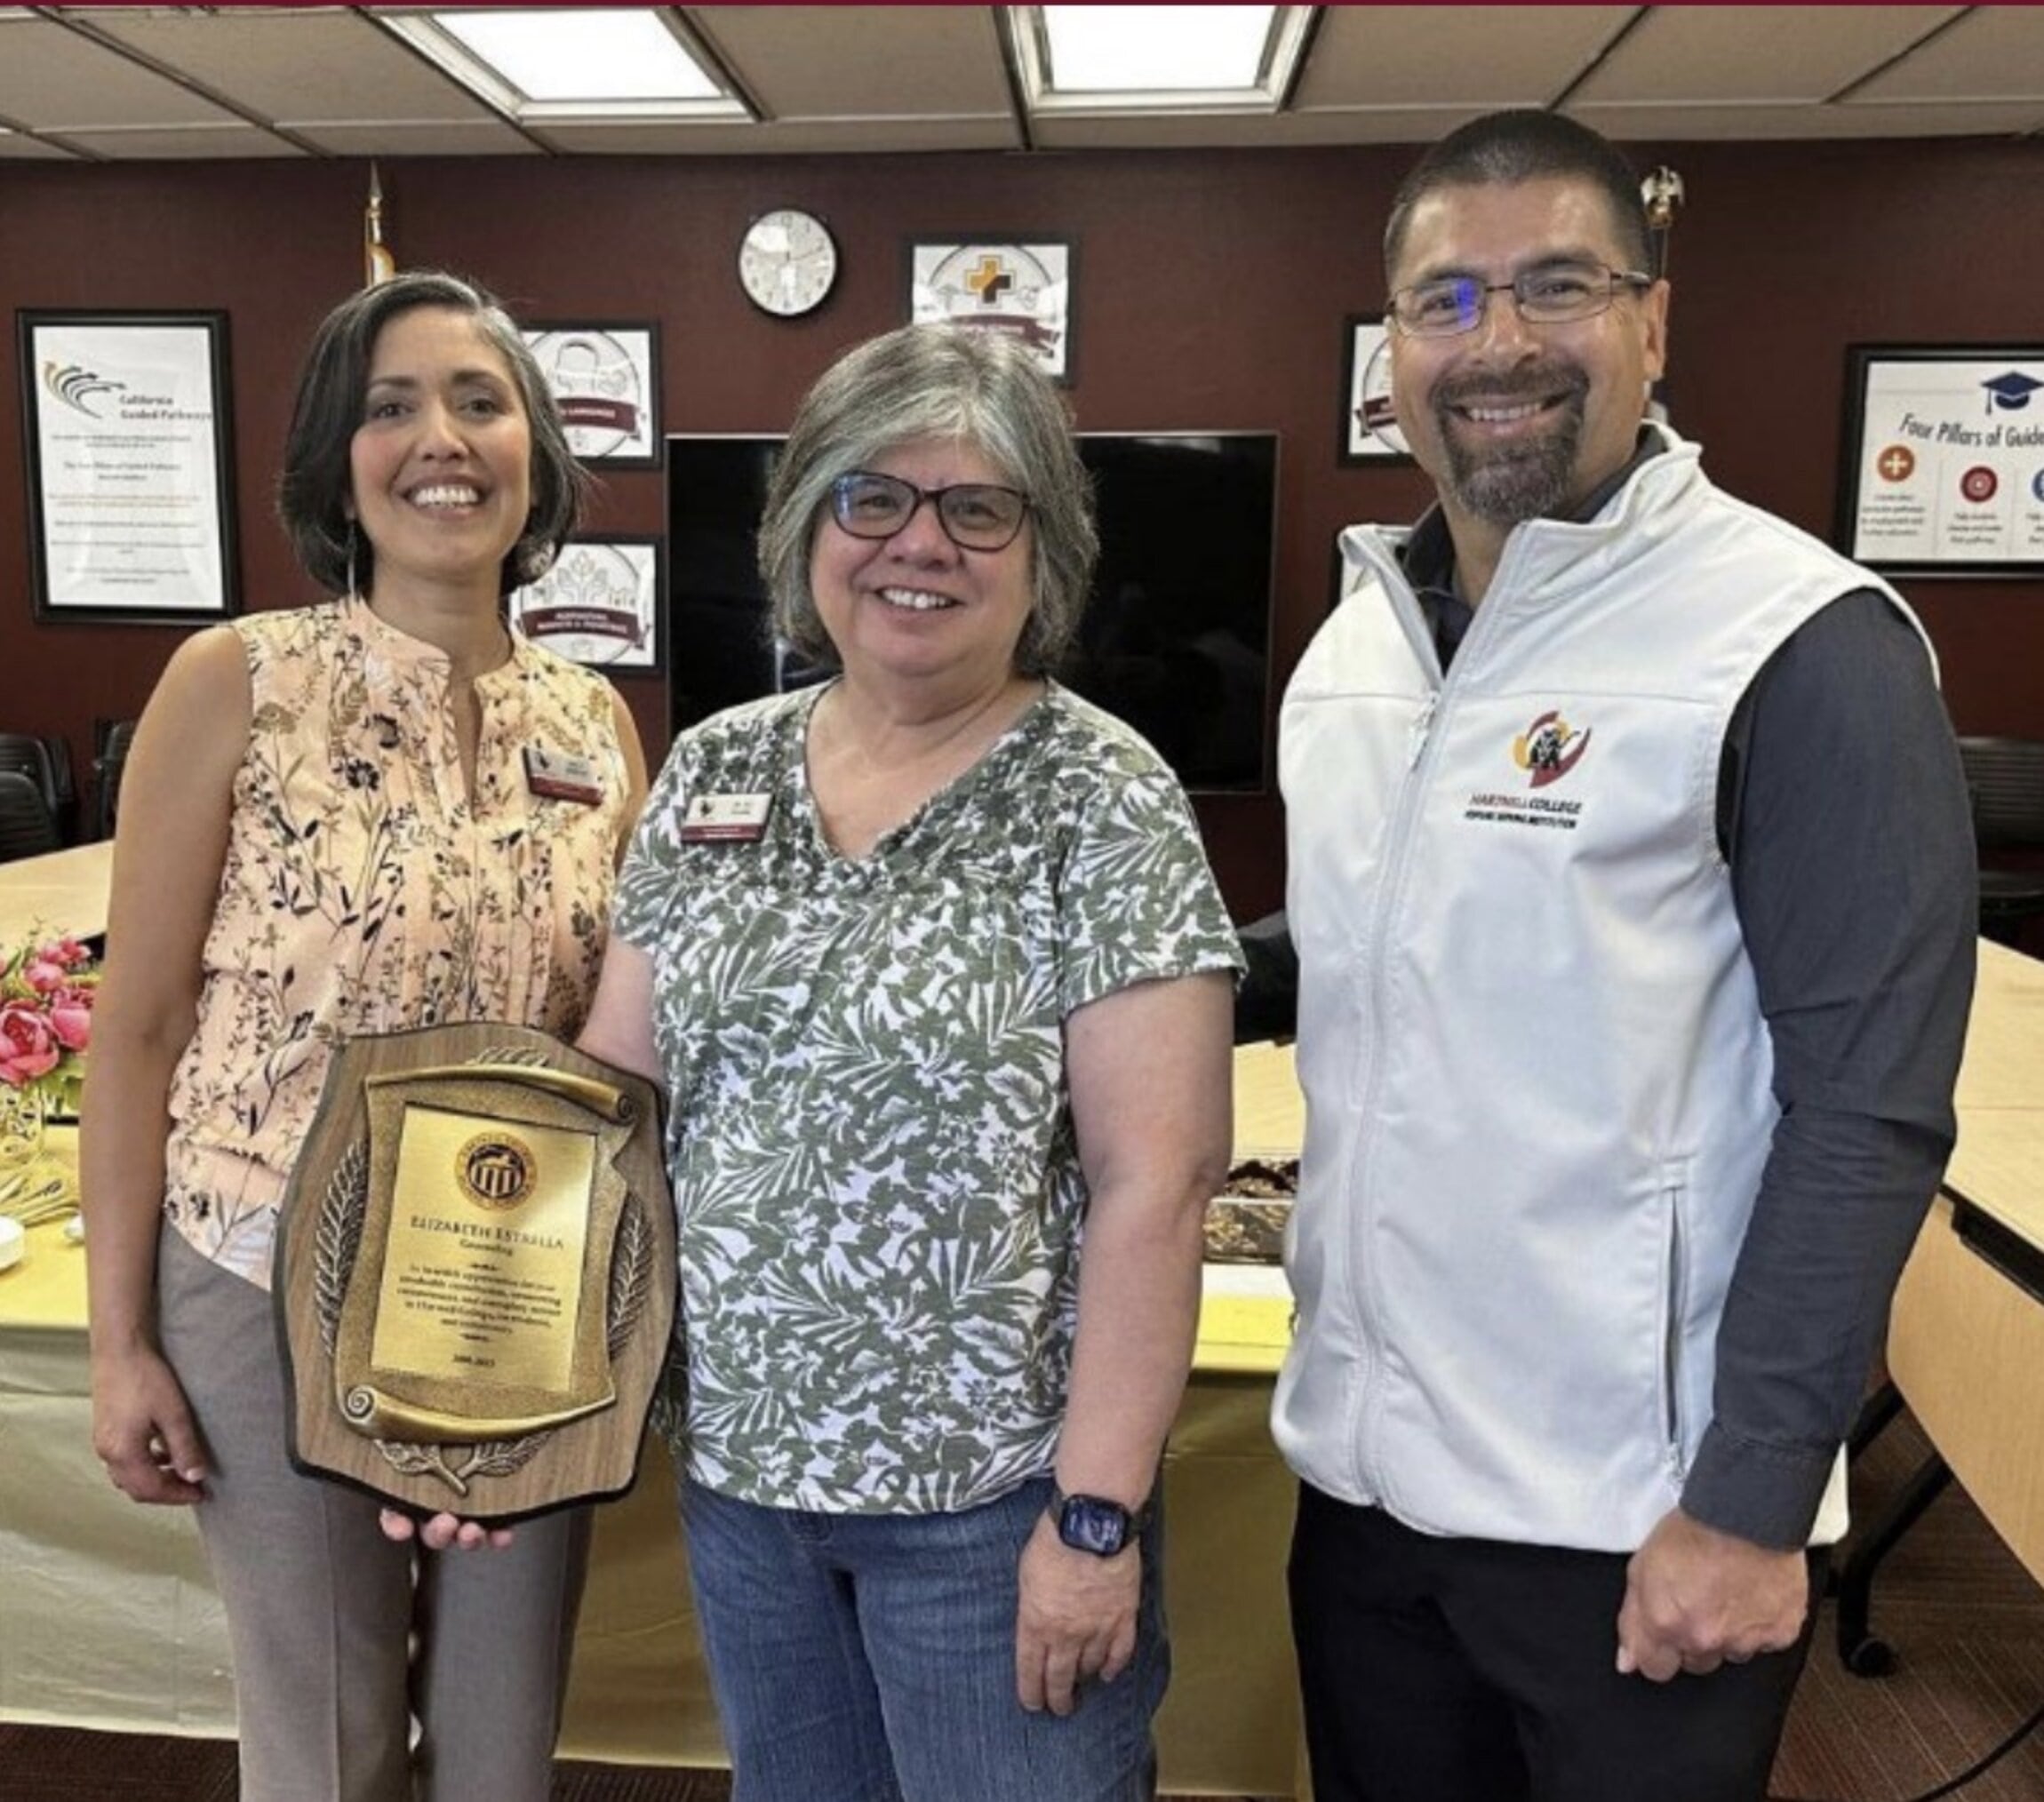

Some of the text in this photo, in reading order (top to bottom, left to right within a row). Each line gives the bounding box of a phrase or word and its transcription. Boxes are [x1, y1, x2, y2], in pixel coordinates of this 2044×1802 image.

[119, 395, 174, 405] California
[121, 409, 157, 419] Guided
[1899, 412, 1934, 439] Four
[1936, 421, 1982, 446] Pillars
[1985, 424, 2002, 447] of
[1529, 798, 1582, 814] COLLEGE
[411, 1216, 564, 1249] ELIZABETH ESTRELLA
